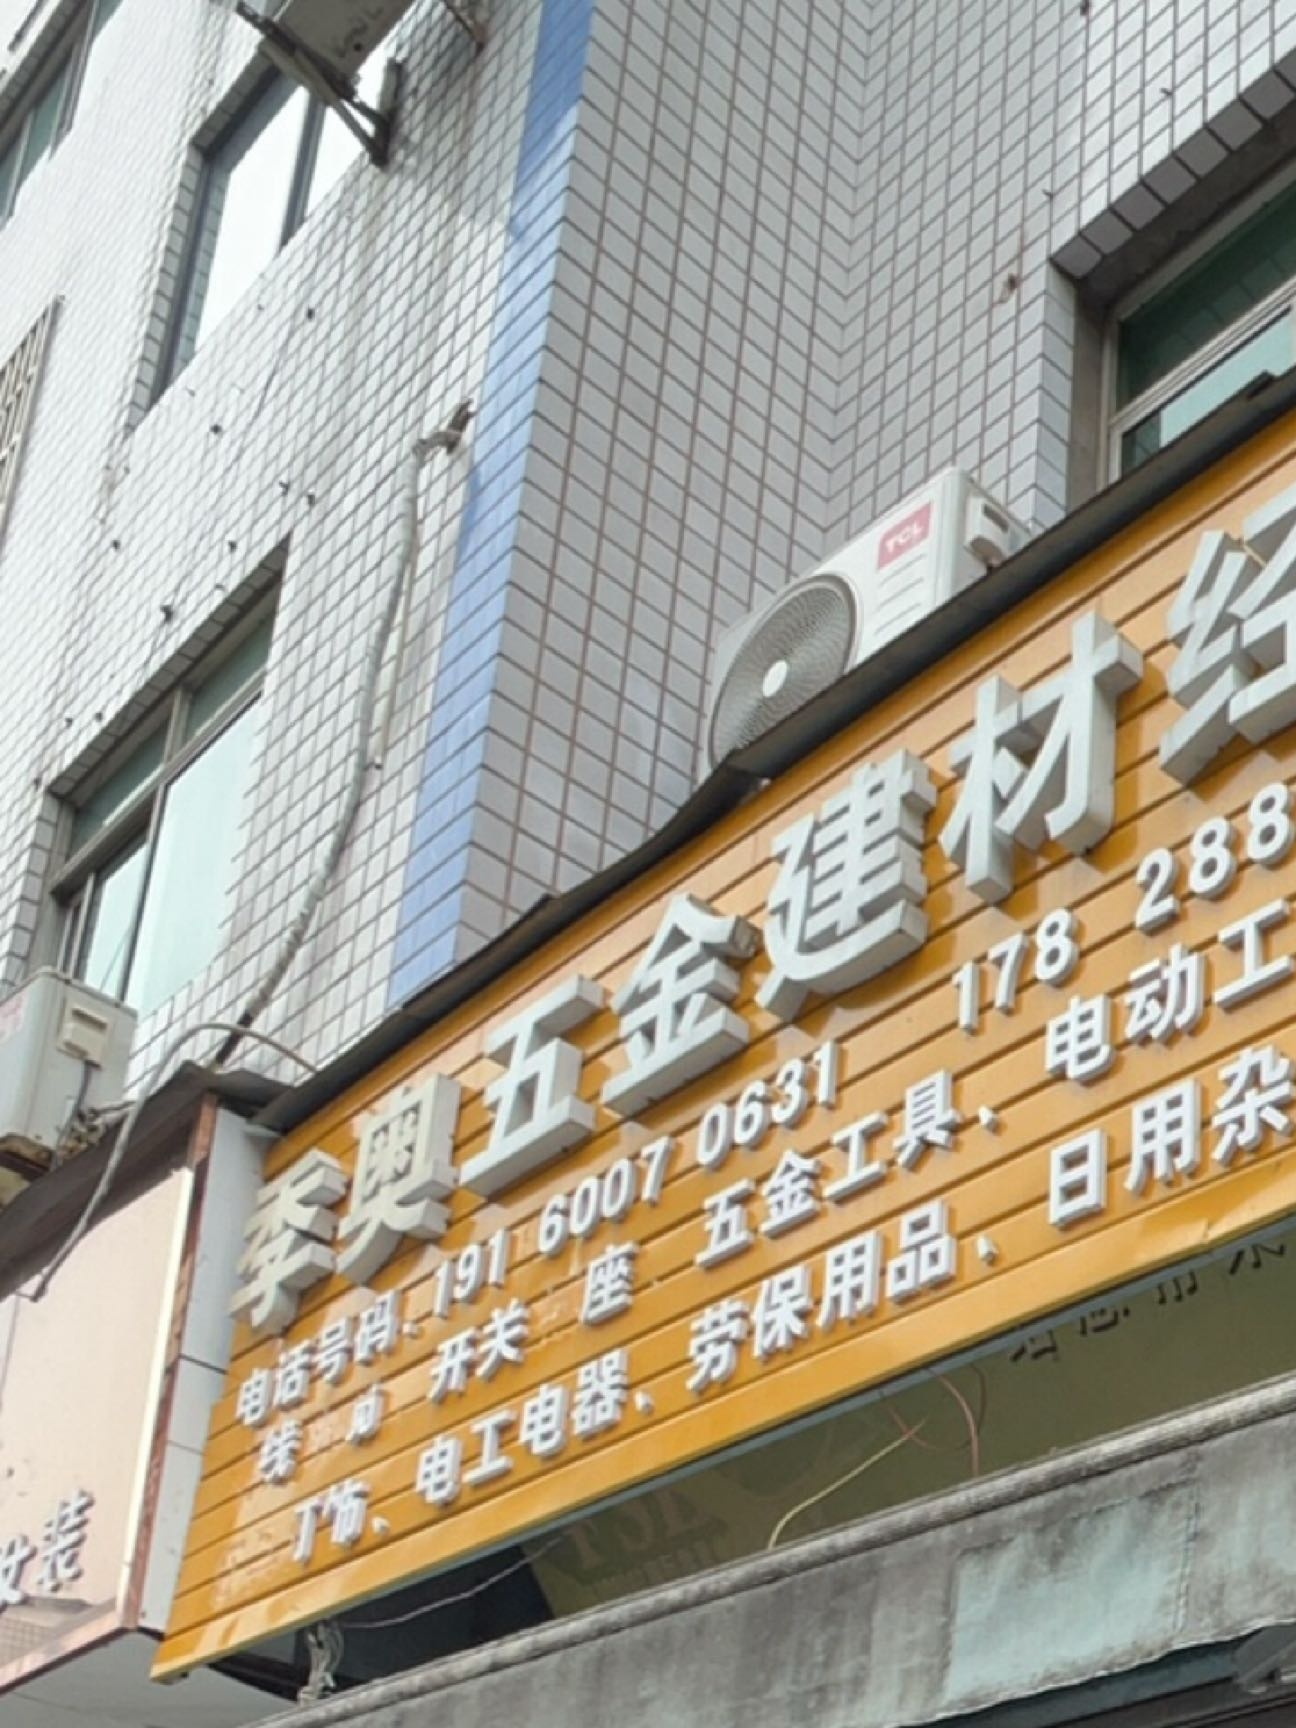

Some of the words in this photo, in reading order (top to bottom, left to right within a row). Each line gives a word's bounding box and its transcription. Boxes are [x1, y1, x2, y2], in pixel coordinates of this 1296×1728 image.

[884, 521, 923, 554] TCL
[434, 1229, 509, 1318] 191
[538, 1137, 677, 1256] 6007
[697, 1040, 841, 1167] 0631
[952, 907, 1080, 1034] 178
